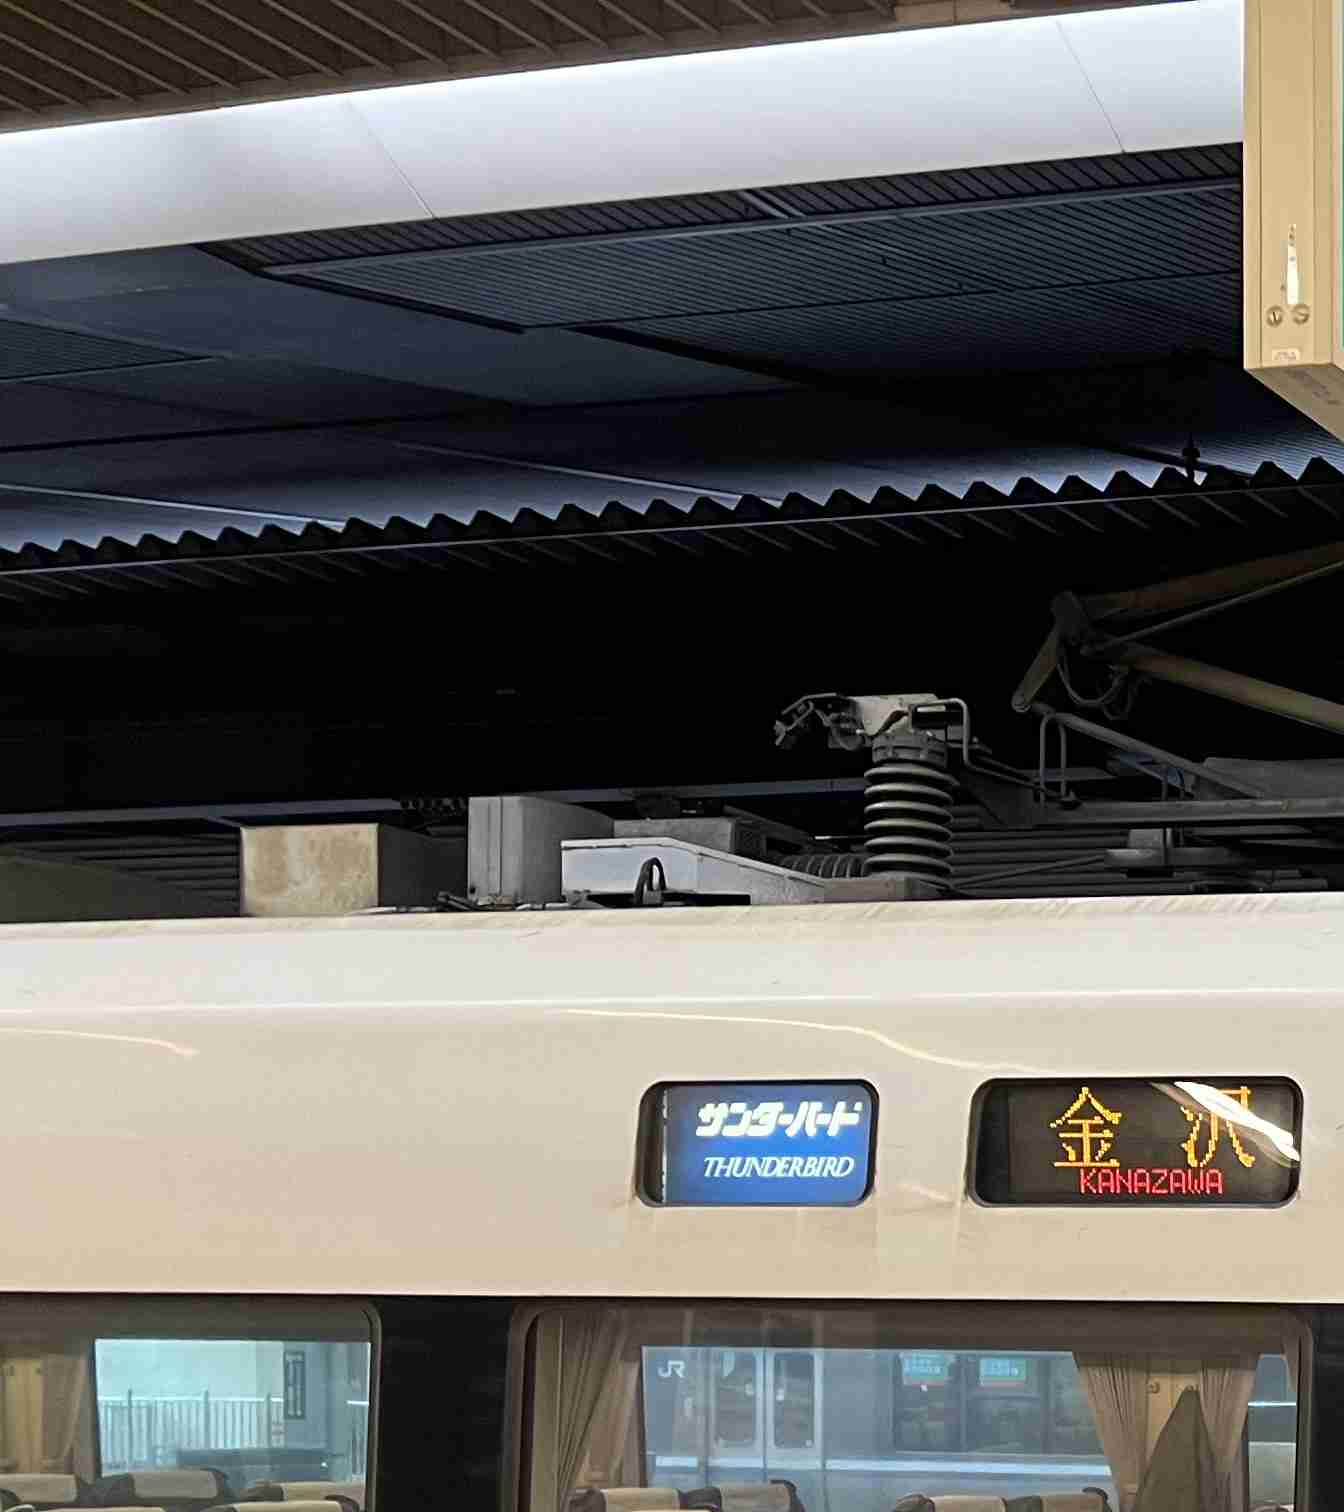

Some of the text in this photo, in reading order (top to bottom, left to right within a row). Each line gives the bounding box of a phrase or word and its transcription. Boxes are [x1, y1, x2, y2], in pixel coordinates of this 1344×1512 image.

[703, 1156, 855, 1178] THUNDERBIRD
[1078, 1168, 1224, 1195] KANAZAWA
[657, 1360, 685, 1378] JR
